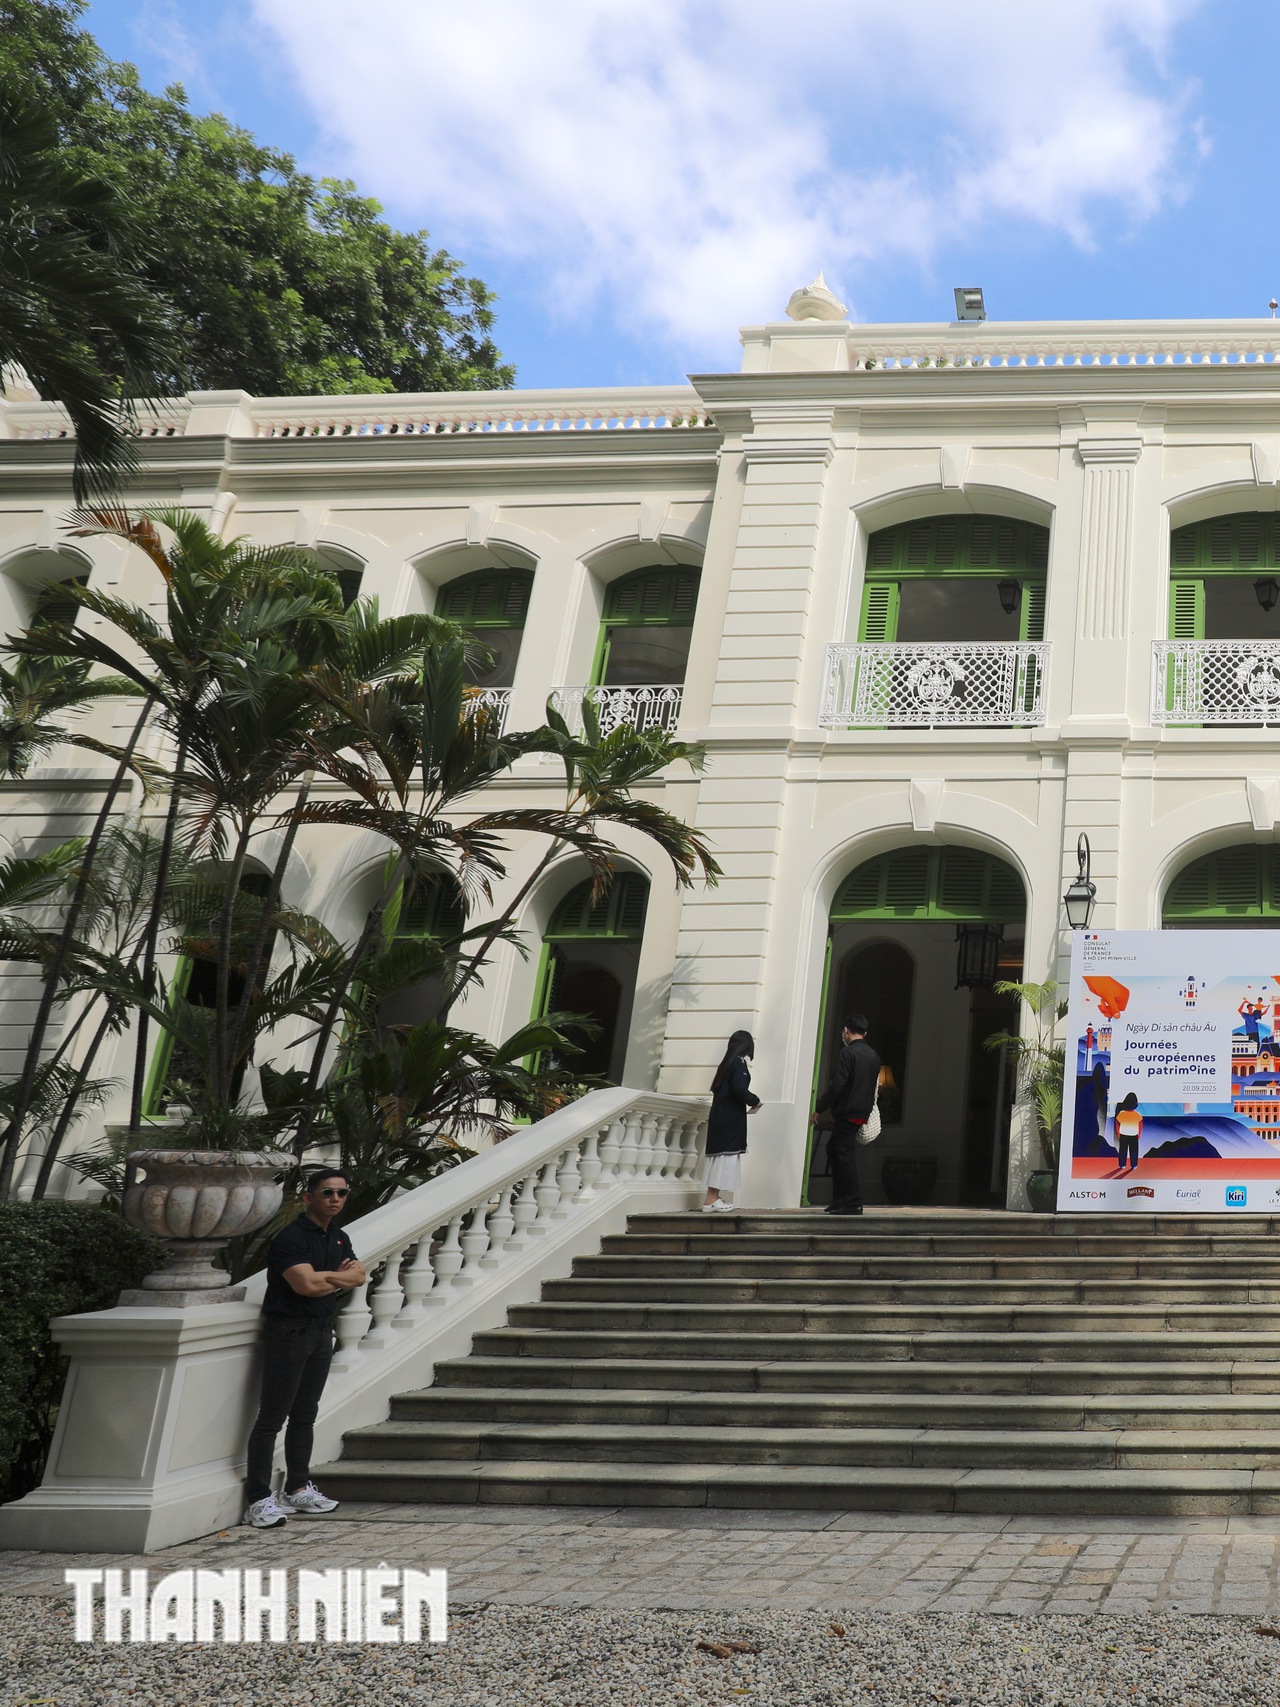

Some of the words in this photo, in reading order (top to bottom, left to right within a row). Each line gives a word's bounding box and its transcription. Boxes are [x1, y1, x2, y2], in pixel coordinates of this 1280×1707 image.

[1125, 1022, 1149, 1034] Ngày
[1151, 1023, 1161, 1031] Di
[1163, 1022, 1178, 1031] sản
[1180, 1022, 1202, 1031] châu
[1203, 1021, 1216, 1031] Âu
[1124, 1039, 1178, 1051] Journées
[1138, 1052, 1216, 1064] européennes
[1124, 1065, 1140, 1075] du
[1147, 1064, 1216, 1077] patrimoine
[1069, 1191, 1106, 1199] ALSTOM
[1176, 1189, 1201, 1198] Eurial
[1228, 1191, 1244, 1200] Kiri
